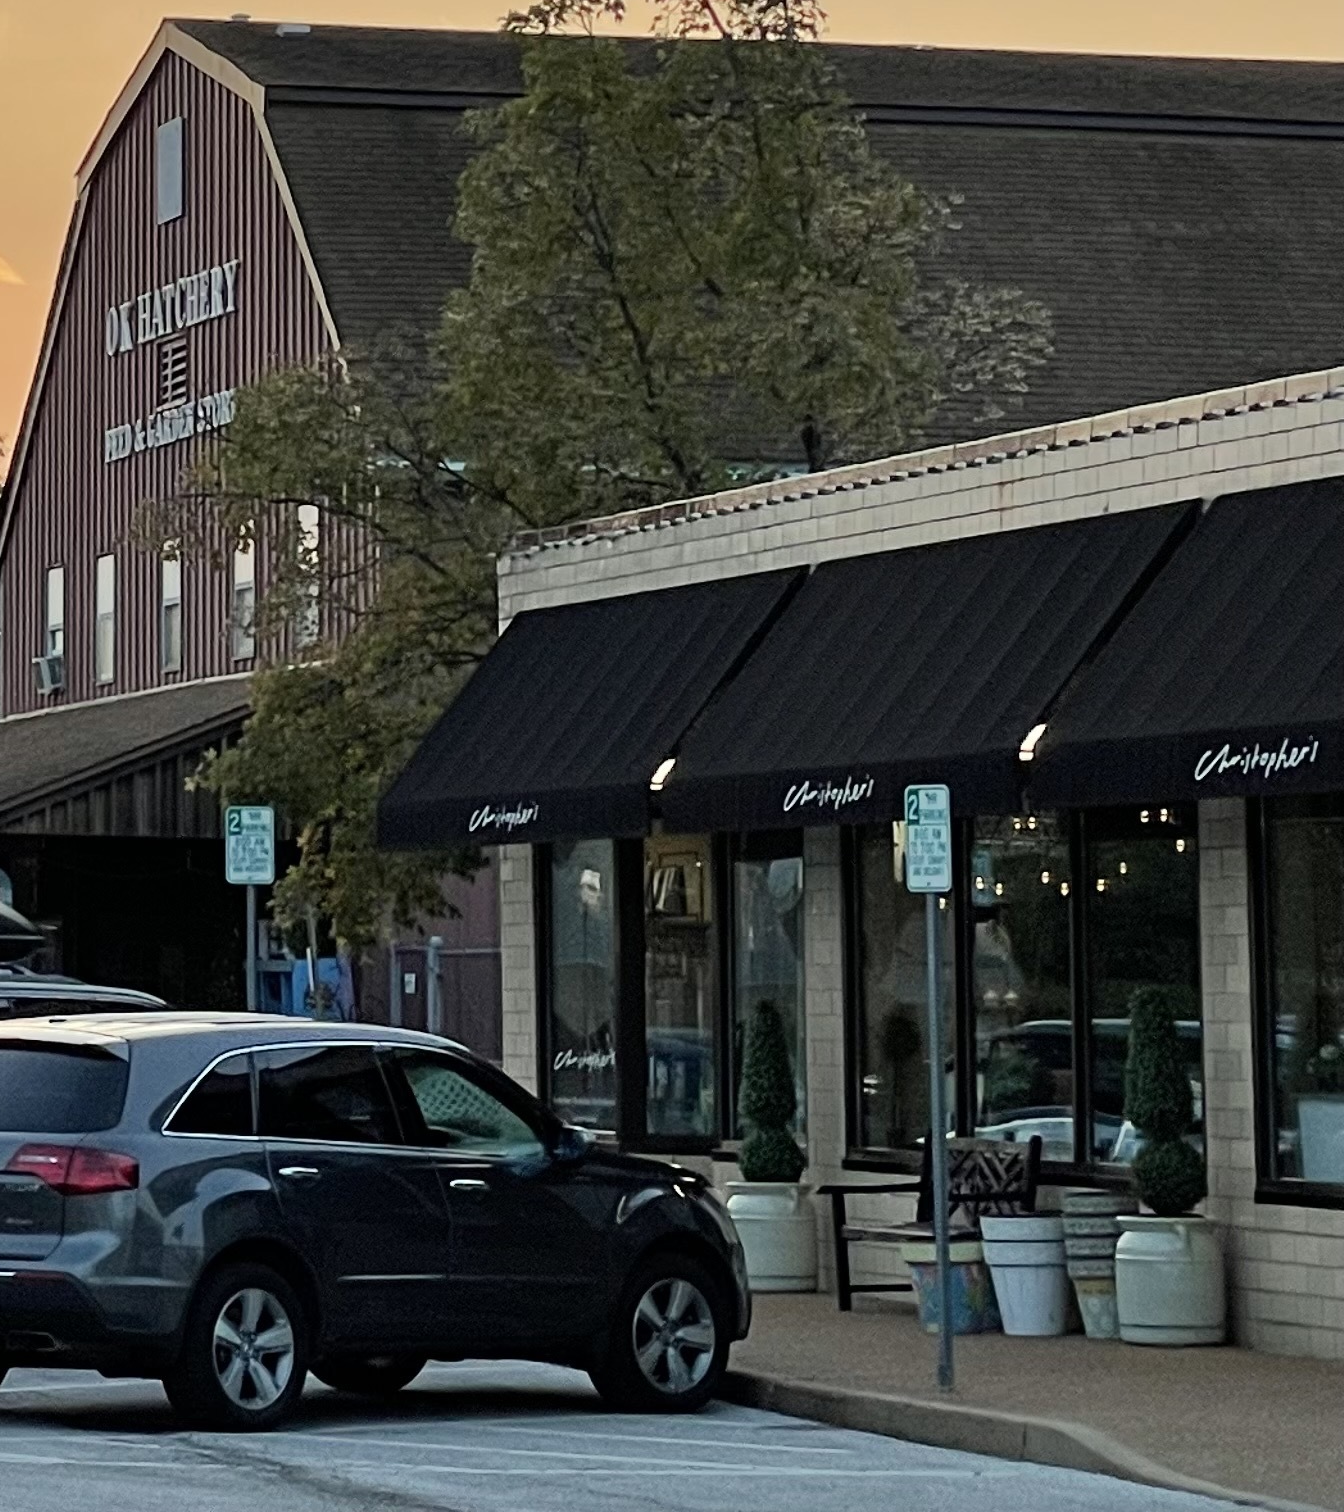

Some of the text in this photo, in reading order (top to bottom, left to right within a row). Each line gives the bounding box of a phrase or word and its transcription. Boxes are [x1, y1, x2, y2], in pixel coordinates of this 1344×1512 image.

[105, 258, 241, 357] OK HATCHERY
[908, 794, 919, 821] 2
[229, 813, 241, 832] 2
